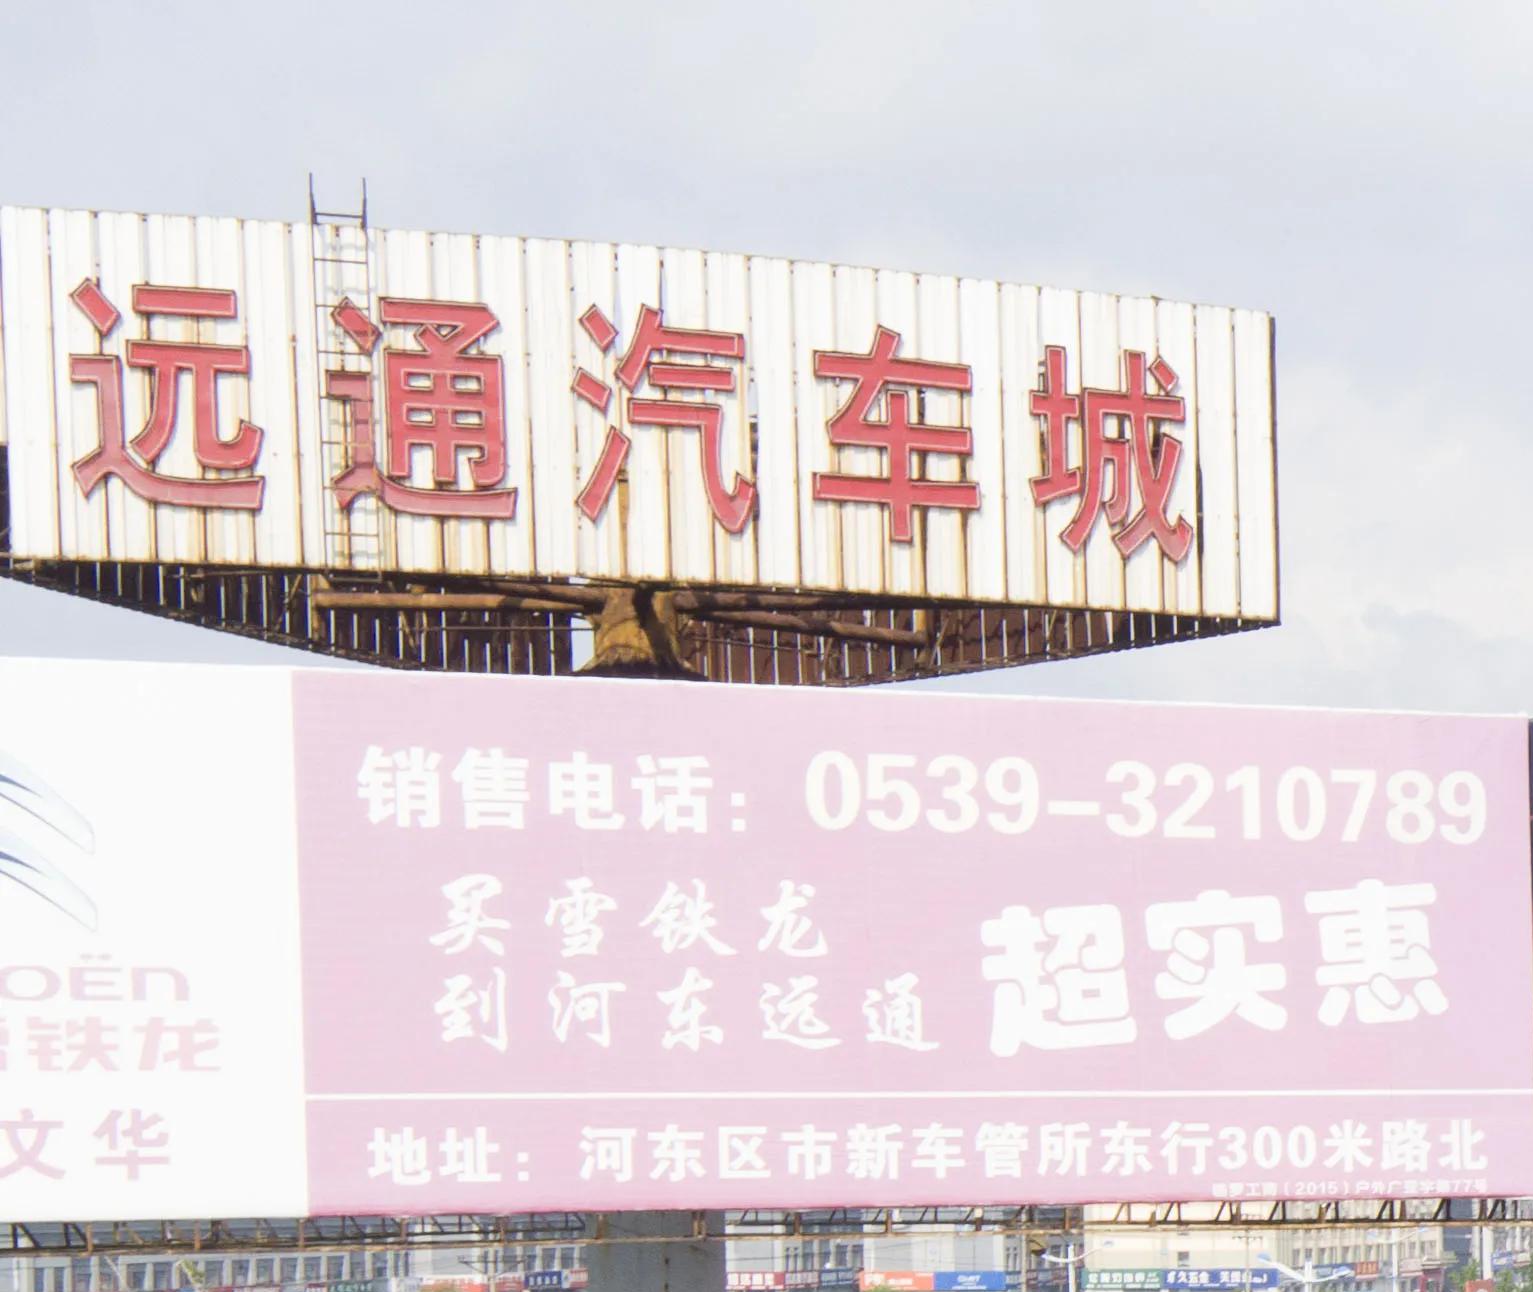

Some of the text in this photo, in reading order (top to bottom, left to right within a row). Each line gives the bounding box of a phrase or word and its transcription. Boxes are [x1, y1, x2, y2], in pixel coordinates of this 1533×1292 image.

[69, 276, 1194, 563] 远通汽车城
[804, 749, 1488, 846] 0539-3210789
[429, 873, 829, 957] 买雪铁龙
[433, 965, 939, 1053] 到河东远通
[980, 878, 1449, 1058] 超实惠
[0, 1015, 222, 1074] 铁龙
[580, 1118, 1488, 1183] 河东区市新车管所东行300米路北
